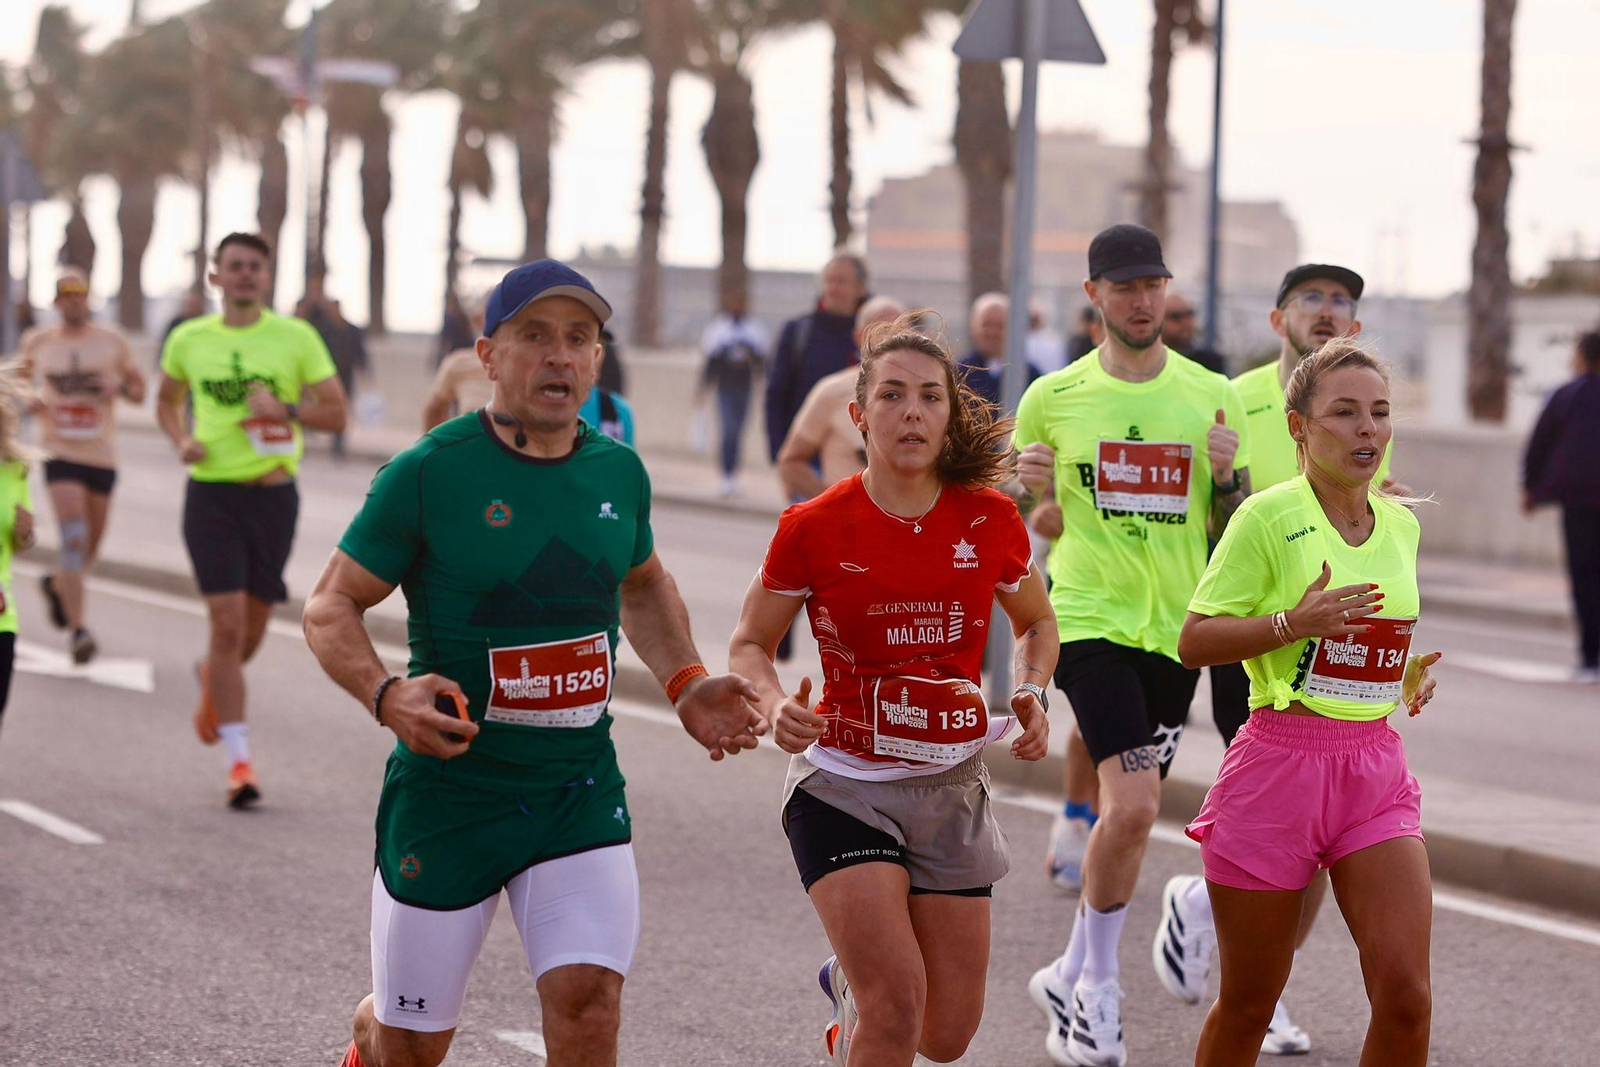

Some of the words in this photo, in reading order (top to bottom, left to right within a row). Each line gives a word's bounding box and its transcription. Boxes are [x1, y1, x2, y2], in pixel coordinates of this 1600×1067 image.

[1149, 466, 1183, 484] 114
[1285, 527, 1309, 543] luanvi
[953, 560, 979, 569] luanvi
[885, 601, 943, 614] GENERALI
[914, 617, 943, 626] MARATÓN
[886, 624, 945, 645] MÁLAGA
[1323, 638, 1370, 657] BRUNCH
[1326, 650, 1350, 665] RUN
[1376, 648, 1405, 668] 134
[498, 675, 550, 690] BRUNCH
[553, 667, 606, 695] 1526
[503, 688, 529, 700] RUN
[880, 700, 928, 720] BRUNCH
[885, 711, 909, 726] RUN
[938, 707, 978, 730] 135
[841, 849, 880, 859] PROJECT
[882, 849, 900, 857] ROCK
